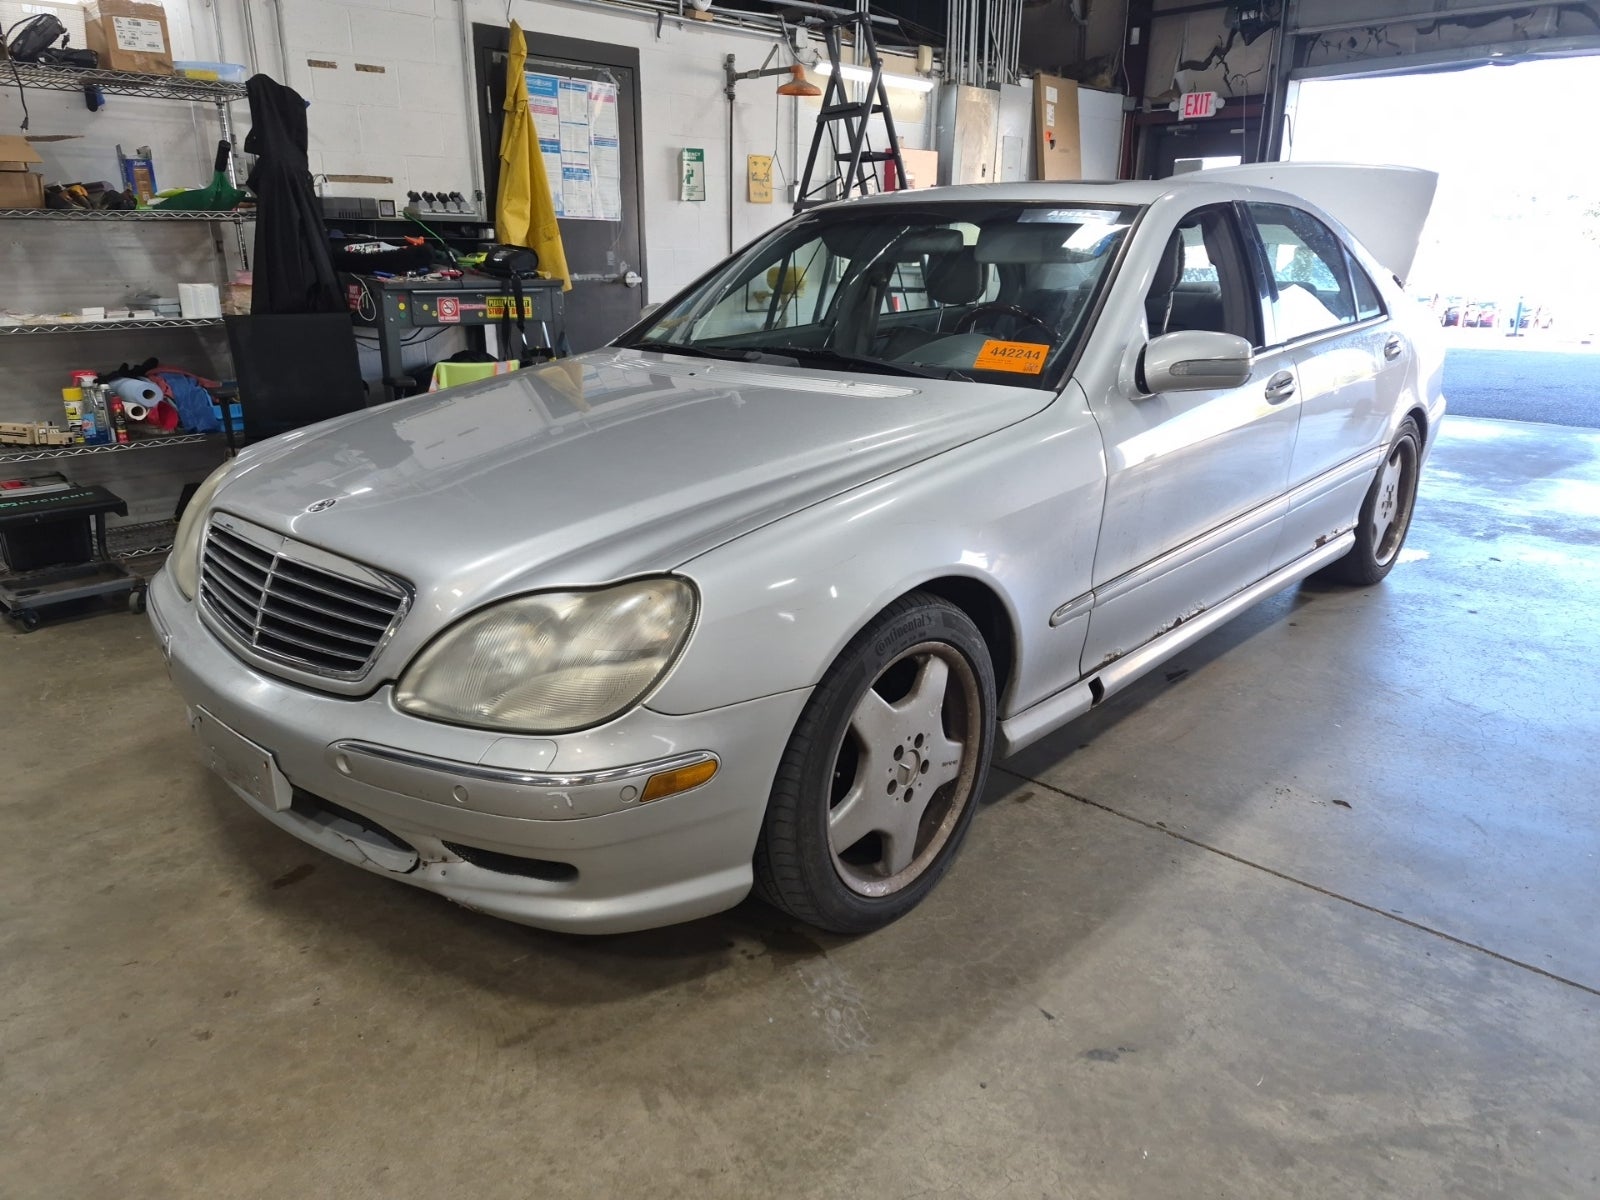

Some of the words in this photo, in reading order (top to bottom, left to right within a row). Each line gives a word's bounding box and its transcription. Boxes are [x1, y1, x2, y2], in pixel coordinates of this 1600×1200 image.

[1185, 93, 1212, 116] EXIT
[990, 346, 1041, 360] 442244
[875, 614, 925, 656] Continental
